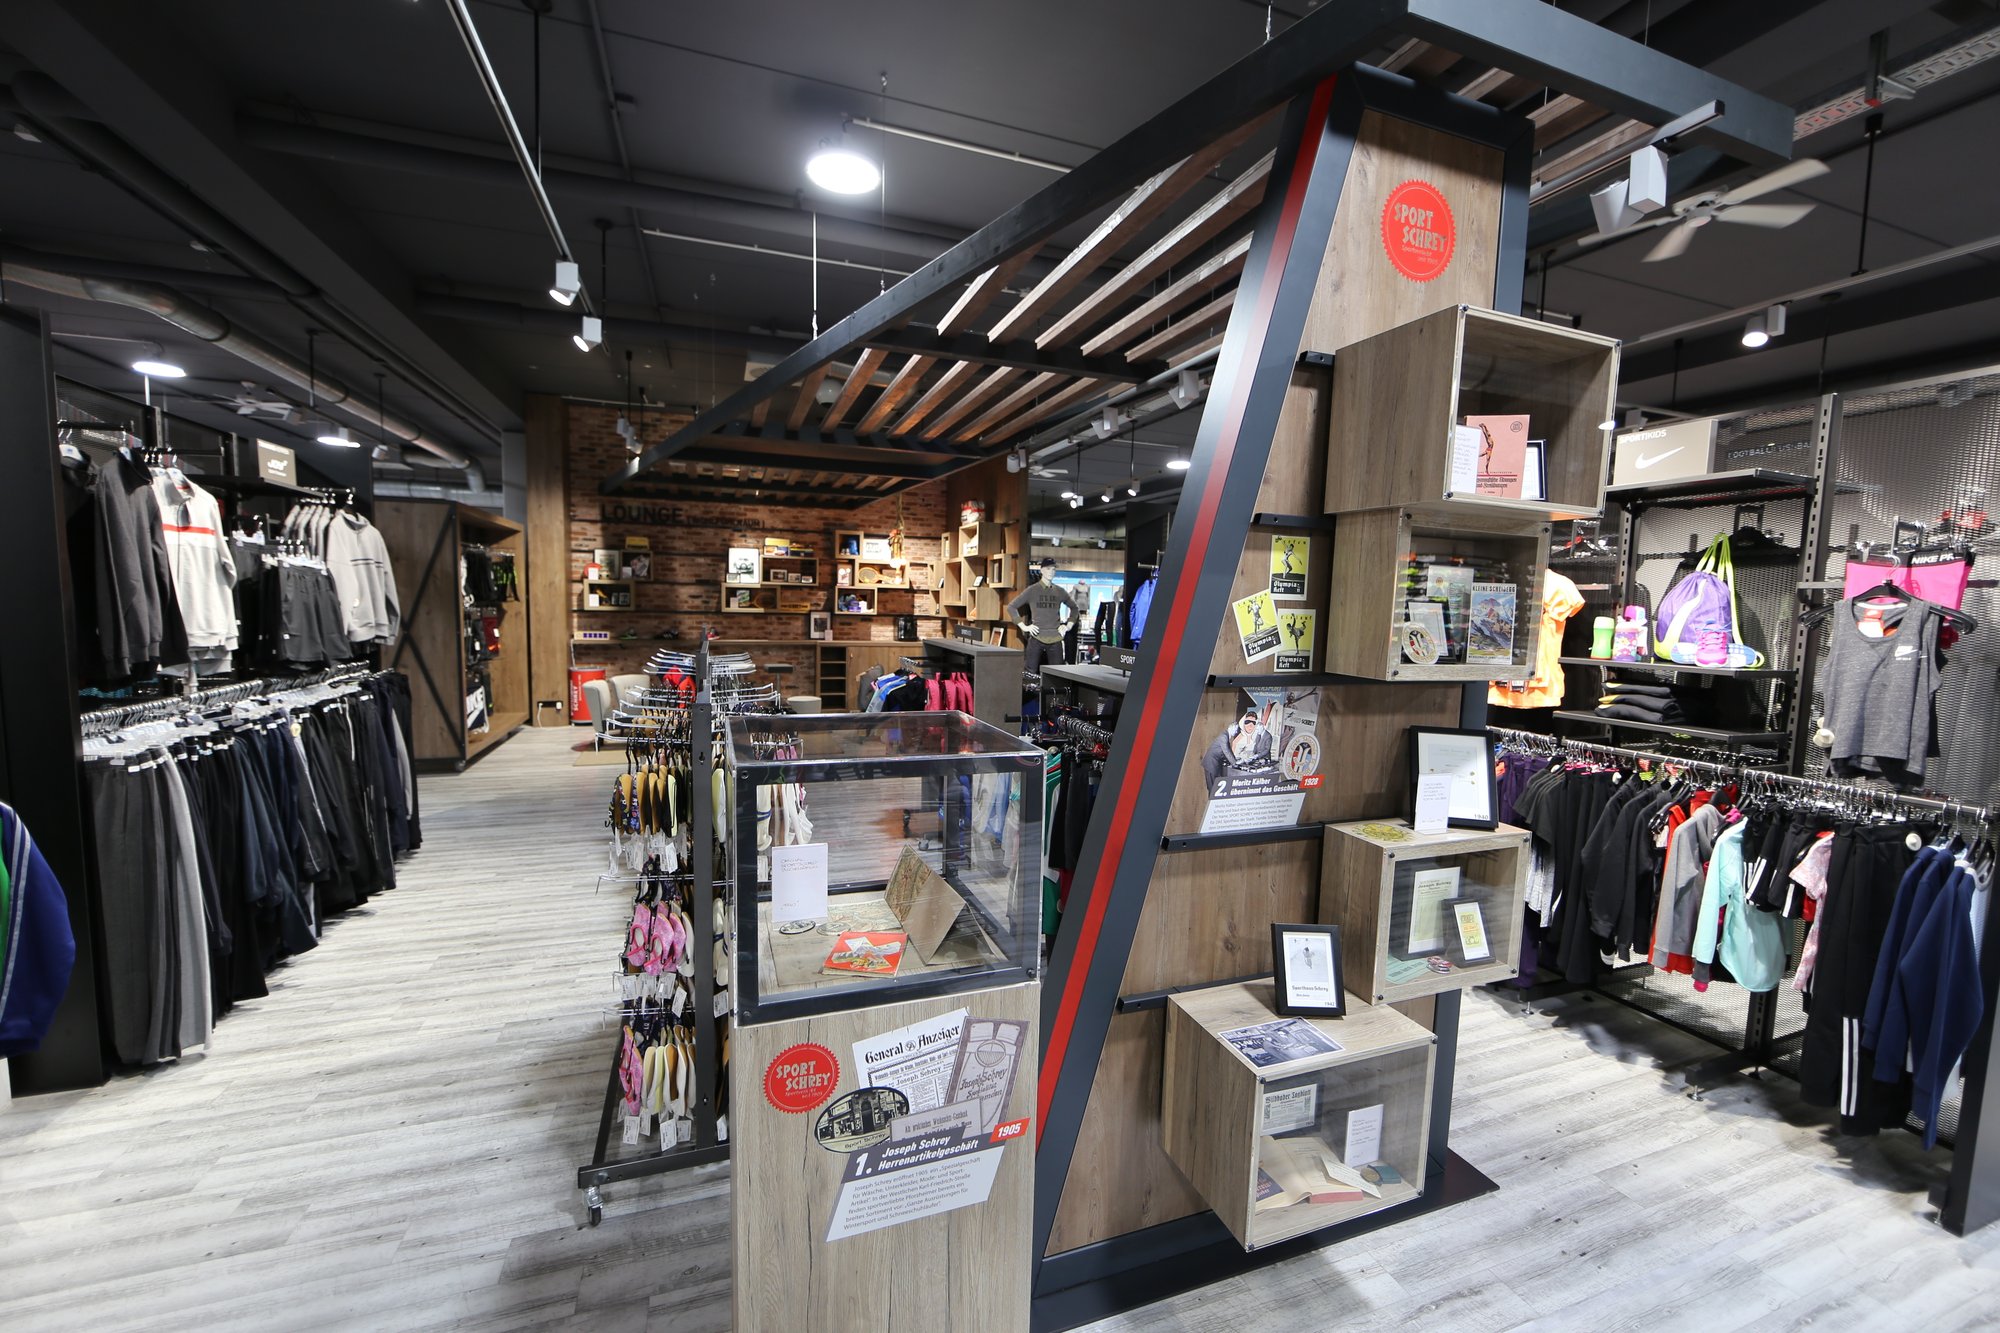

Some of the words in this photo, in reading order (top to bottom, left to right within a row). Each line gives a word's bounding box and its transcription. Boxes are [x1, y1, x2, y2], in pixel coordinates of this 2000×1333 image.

[1394, 202, 1434, 229] SPORT
[1402, 226, 1446, 252] SCHREY
[601, 504, 684, 522] LOUNGE
[1911, 556, 1939, 564] NIKE
[1214, 780, 1228, 797] 2.
[1230, 787, 1262, 796] übernimmt
[1273, 784, 1299, 792] Geschäft
[1232, 779, 1251, 787] Moritz
[1252, 777, 1271, 786] Kälber
[864, 1042, 904, 1065] General
[917, 1025, 960, 1050] Anzeiger
[775, 1060, 817, 1079] SPORT
[896, 1074, 919, 1086] Joseph
[919, 1066, 942, 1077] Schrey
[785, 1073, 831, 1091] SCHREY
[997, 1122, 1022, 1138] 1905
[878, 1139, 979, 1171] Herrenartikelgeschäft
[882, 1142, 916, 1159] Joseph
[918, 1135, 951, 1151] Schrey
[855, 1153, 872, 1177] 1.
[854, 1183, 874, 1192] Joseph
[874, 1178, 892, 1188] Schrey
[878, 1192, 888, 1200] der
[888, 1185, 918, 1198] Westlichen
[845, 1214, 865, 1222] breites
[865, 1206, 893, 1218] Sortiment
[924, 1190, 960, 1204] Ausrüstungen
[848, 1206, 867, 1214] finden
[867, 1197, 904, 1212] sportverliebte
[905, 1189, 937, 1201] Pforzheimer
[937, 1184, 955, 1193] bereits
[843, 1218, 879, 1230] Wintersport
[880, 1214, 889, 1222] und
